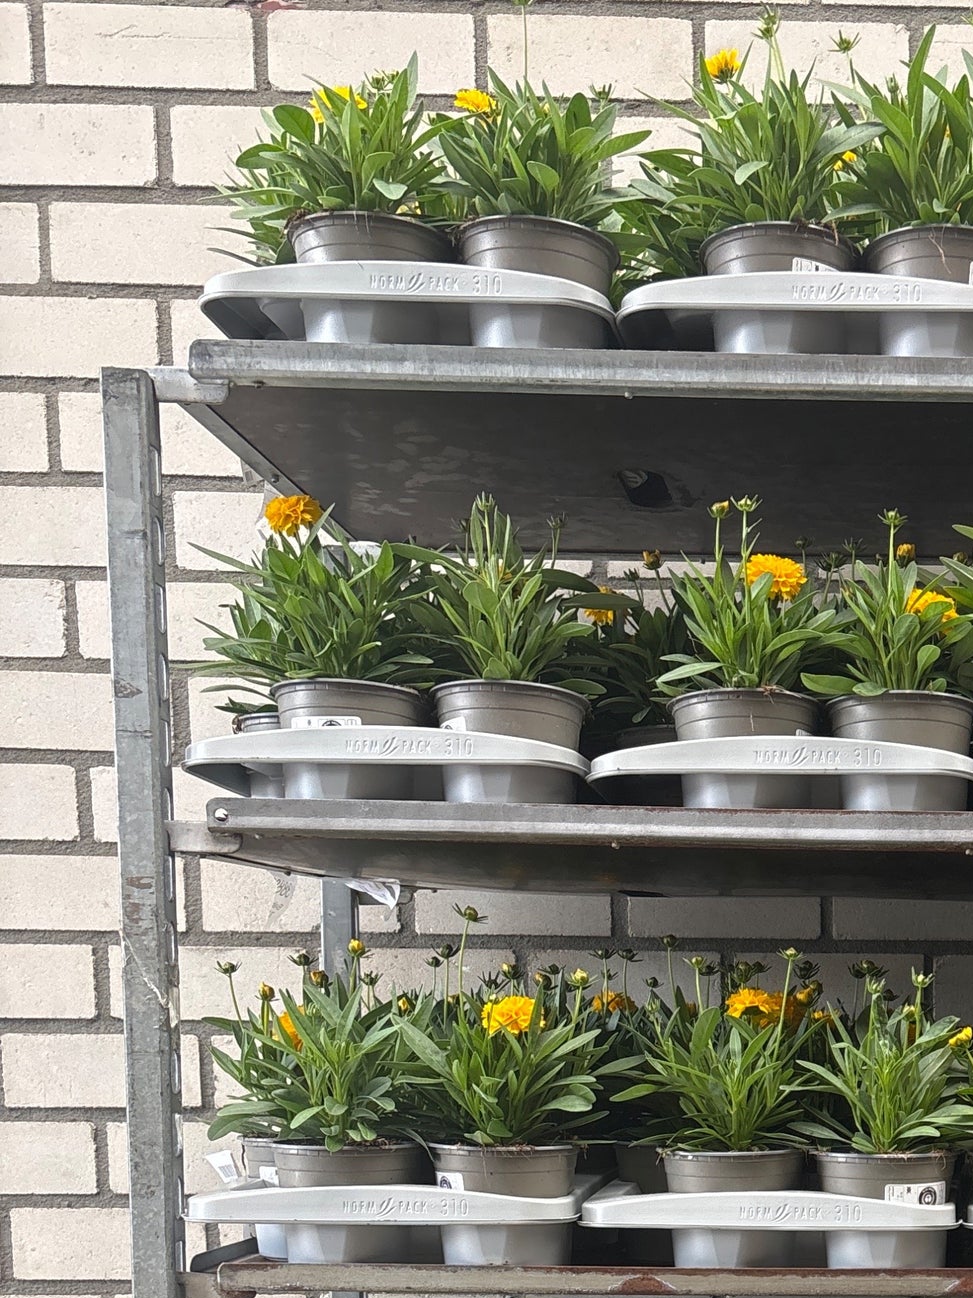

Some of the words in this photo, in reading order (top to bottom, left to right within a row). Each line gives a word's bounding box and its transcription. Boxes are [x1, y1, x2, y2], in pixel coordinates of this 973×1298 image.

[370, 275, 405, 290] NORM
[473, 275, 502, 294] 310
[792, 285, 827, 301] NORM
[893, 284, 922, 302] 310
[346, 739, 379, 754] NORM
[445, 739, 473, 756] 310
[754, 751, 788, 764] NORM
[854, 748, 881, 766] 310
[343, 1200, 376, 1214] NORM
[440, 1199, 468, 1216] 310
[740, 1206, 771, 1219] NORM
[834, 1205, 862, 1223] 310
